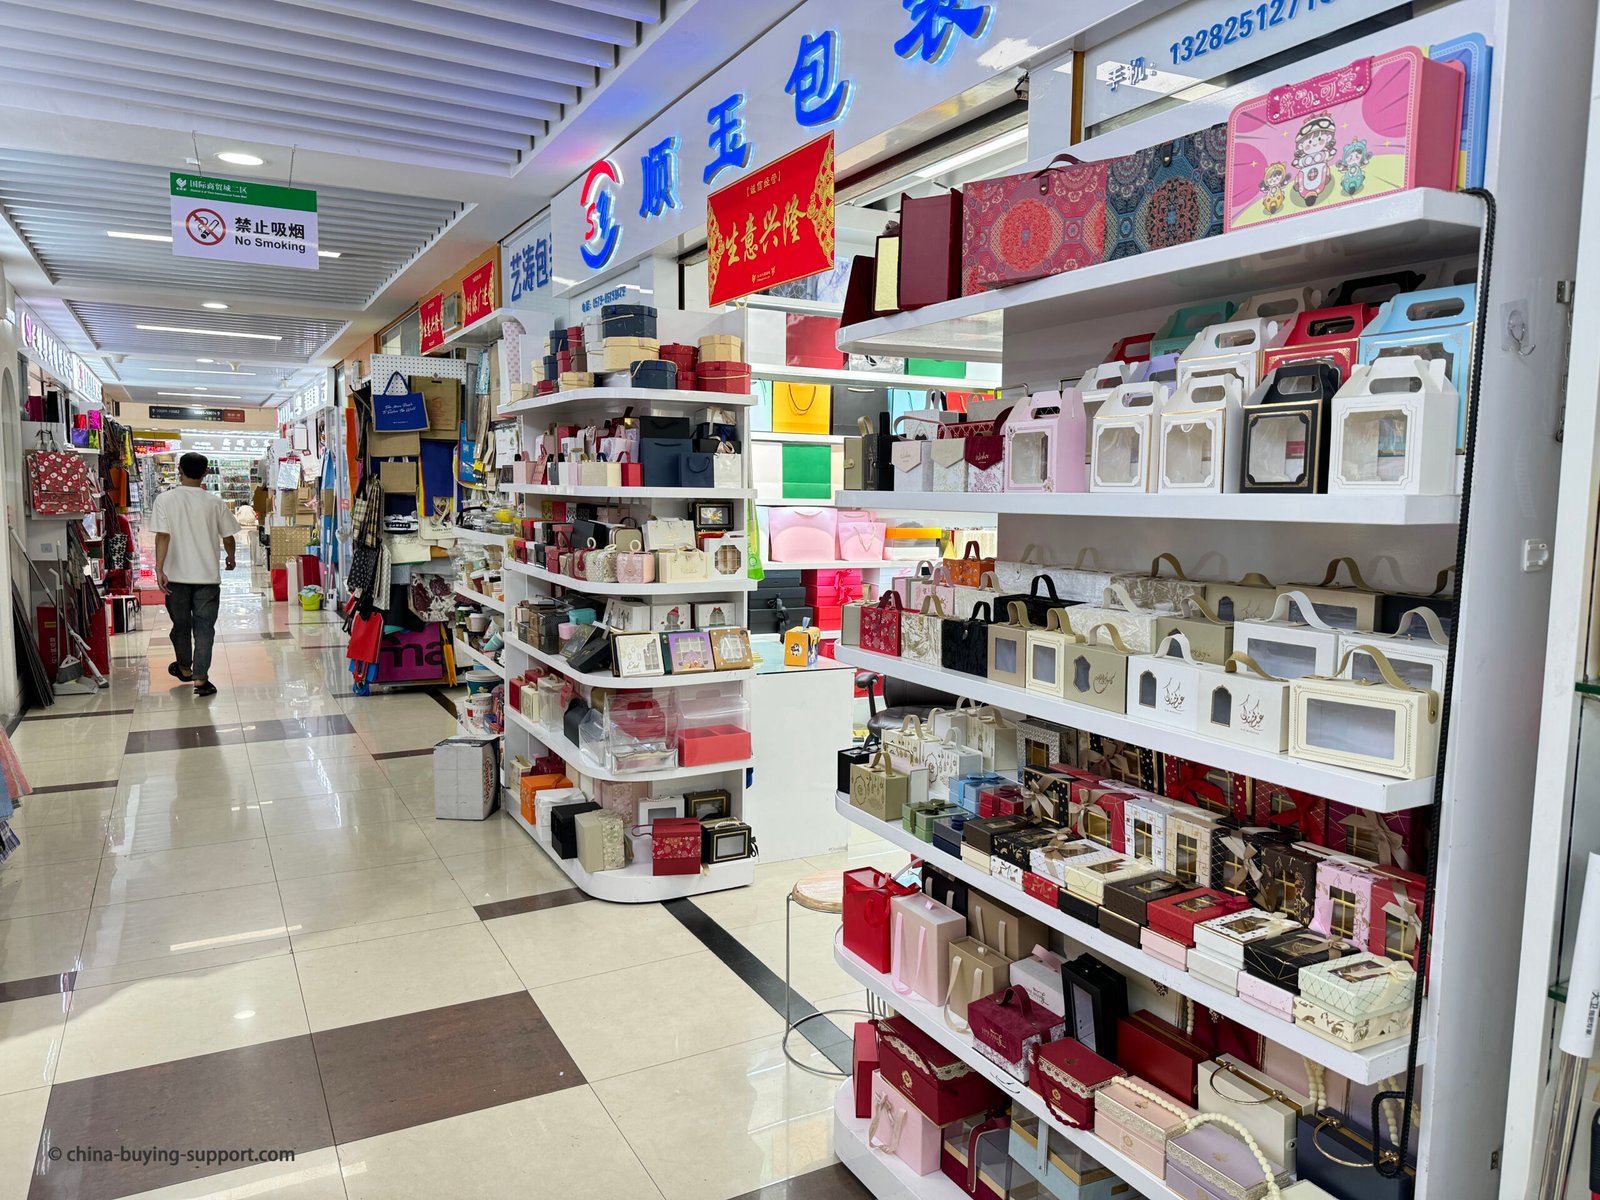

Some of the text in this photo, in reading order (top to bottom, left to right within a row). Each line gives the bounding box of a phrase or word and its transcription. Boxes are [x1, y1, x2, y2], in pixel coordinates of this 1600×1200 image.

[1169, 0, 1334, 64] 132825127
[235, 216, 305, 240] 禁止吸烟
[235, 235, 306, 254] No Smoking
[725, 193, 807, 267] 生意兴隆
[510, 231, 552, 302] 艺涛包
